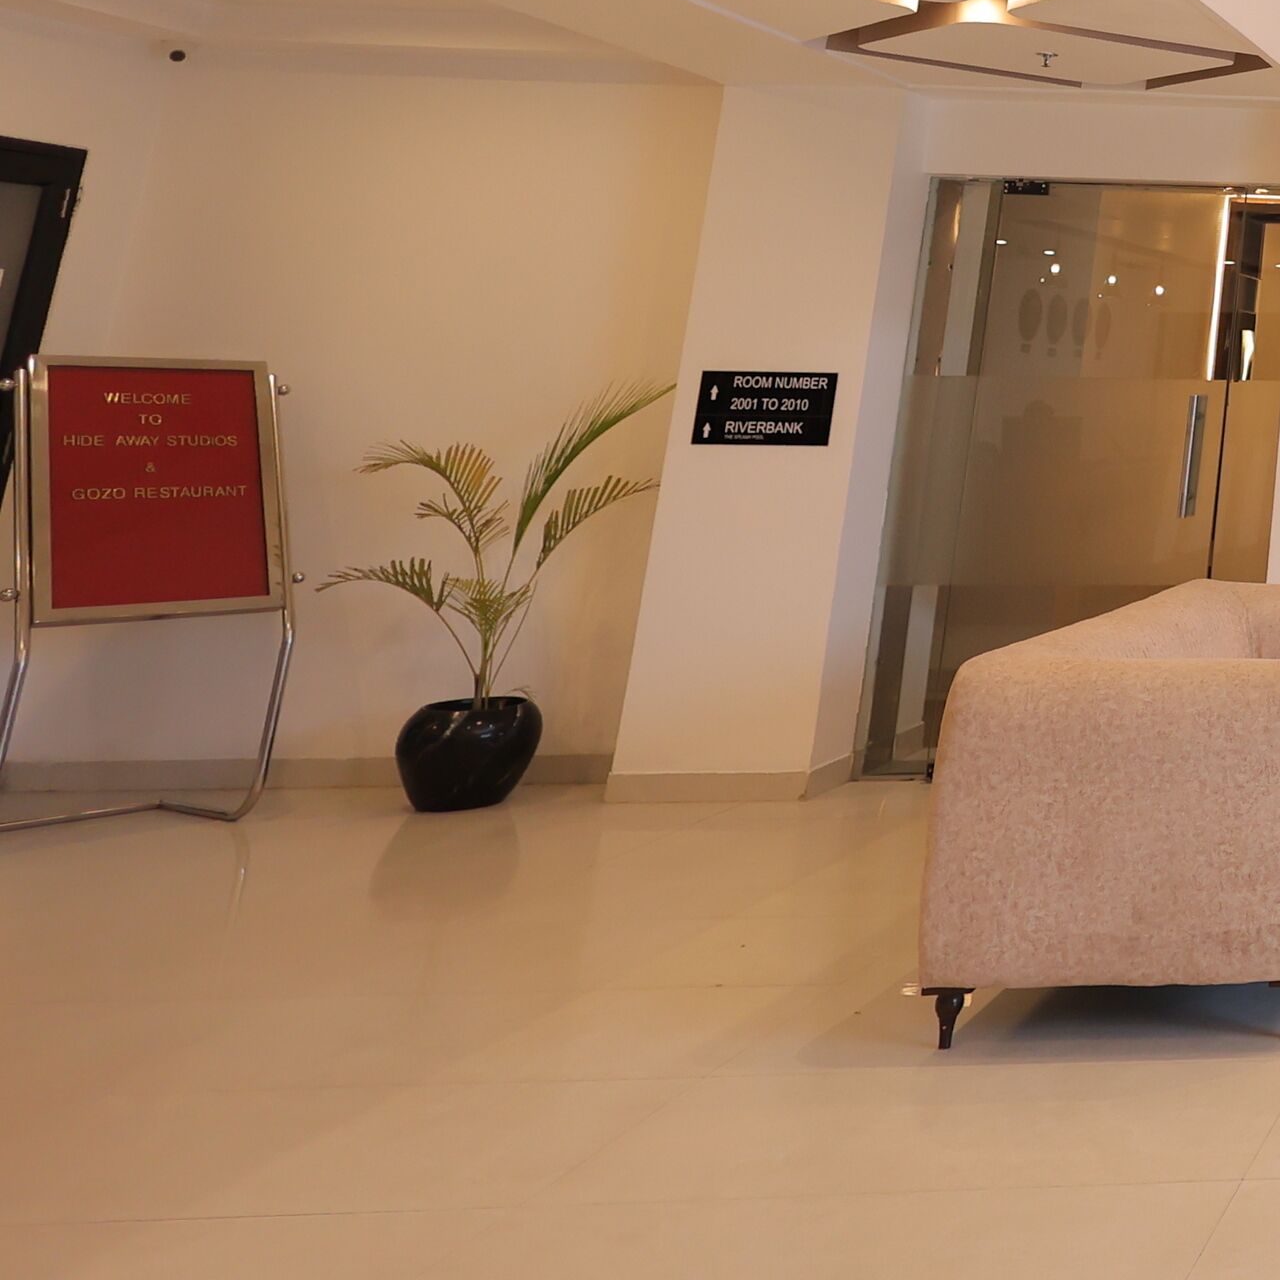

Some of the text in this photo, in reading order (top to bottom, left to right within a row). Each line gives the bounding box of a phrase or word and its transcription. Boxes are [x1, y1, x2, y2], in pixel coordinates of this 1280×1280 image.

[733, 375, 828, 390] ROOM NUMBER
[104, 392, 192, 405] WELCOME
[730, 397, 809, 412] 2001 TO 2010
[138, 413, 162, 425] TO
[724, 420, 804, 435] RIVERBANK
[63, 434, 238, 447] HIDE AWAY STUDIOS
[145, 462, 156, 473] &
[72, 485, 248, 500] GOZO RESTAURANT
